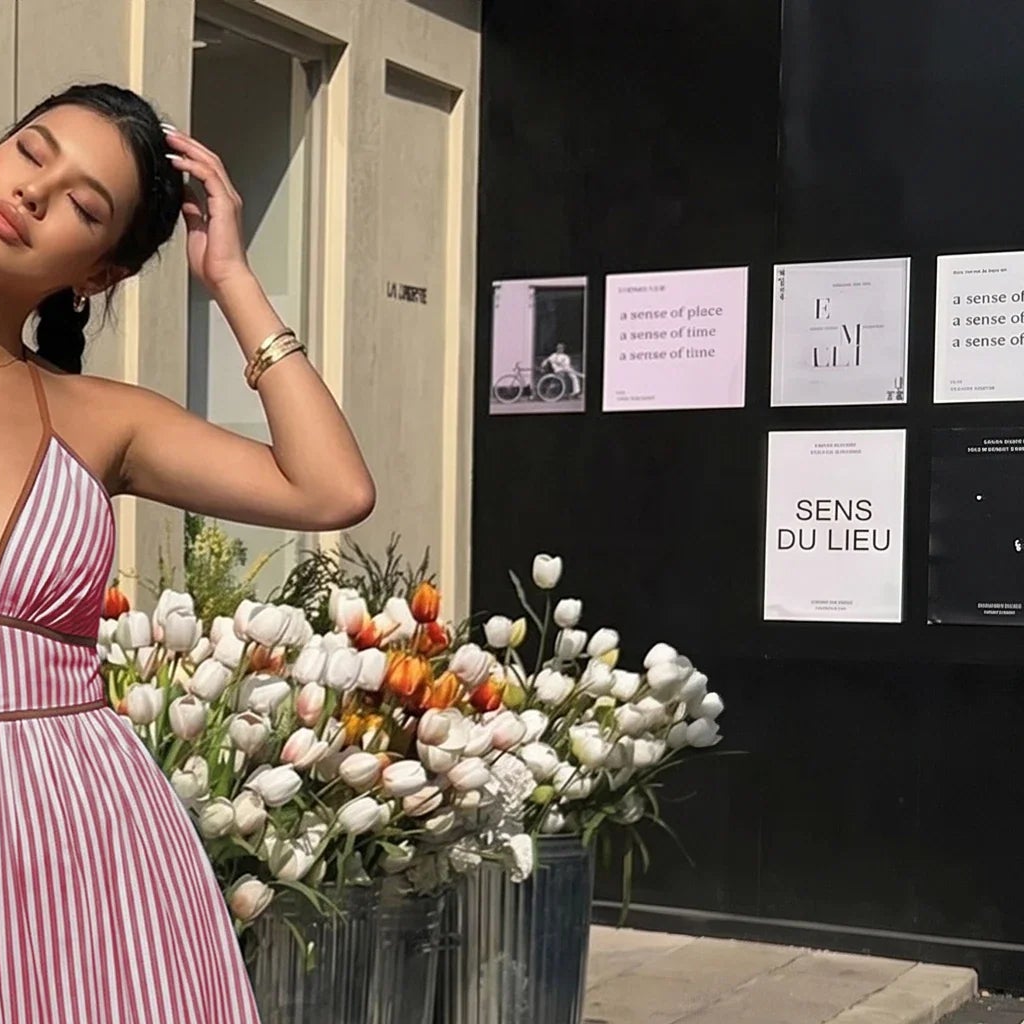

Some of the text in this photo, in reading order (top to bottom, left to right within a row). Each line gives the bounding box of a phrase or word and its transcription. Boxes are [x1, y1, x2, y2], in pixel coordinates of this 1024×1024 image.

[953, 296, 960, 305] a
[966, 294, 1007, 304] sense
[630, 310, 668, 320] sense
[670, 305, 685, 318] of
[687, 305, 723, 320] place
[952, 317, 960, 326] a
[966, 315, 1006, 325] sense
[630, 330, 667, 340] sense
[670, 326, 685, 338] of
[686, 326, 716, 338] time
[952, 338, 960, 347] a
[965, 336, 1006, 347] sense
[629, 350, 667, 360] sense
[669, 346, 685, 359] of
[796, 499, 872, 521] SENS
[777, 528, 890, 551] DU LIEU
